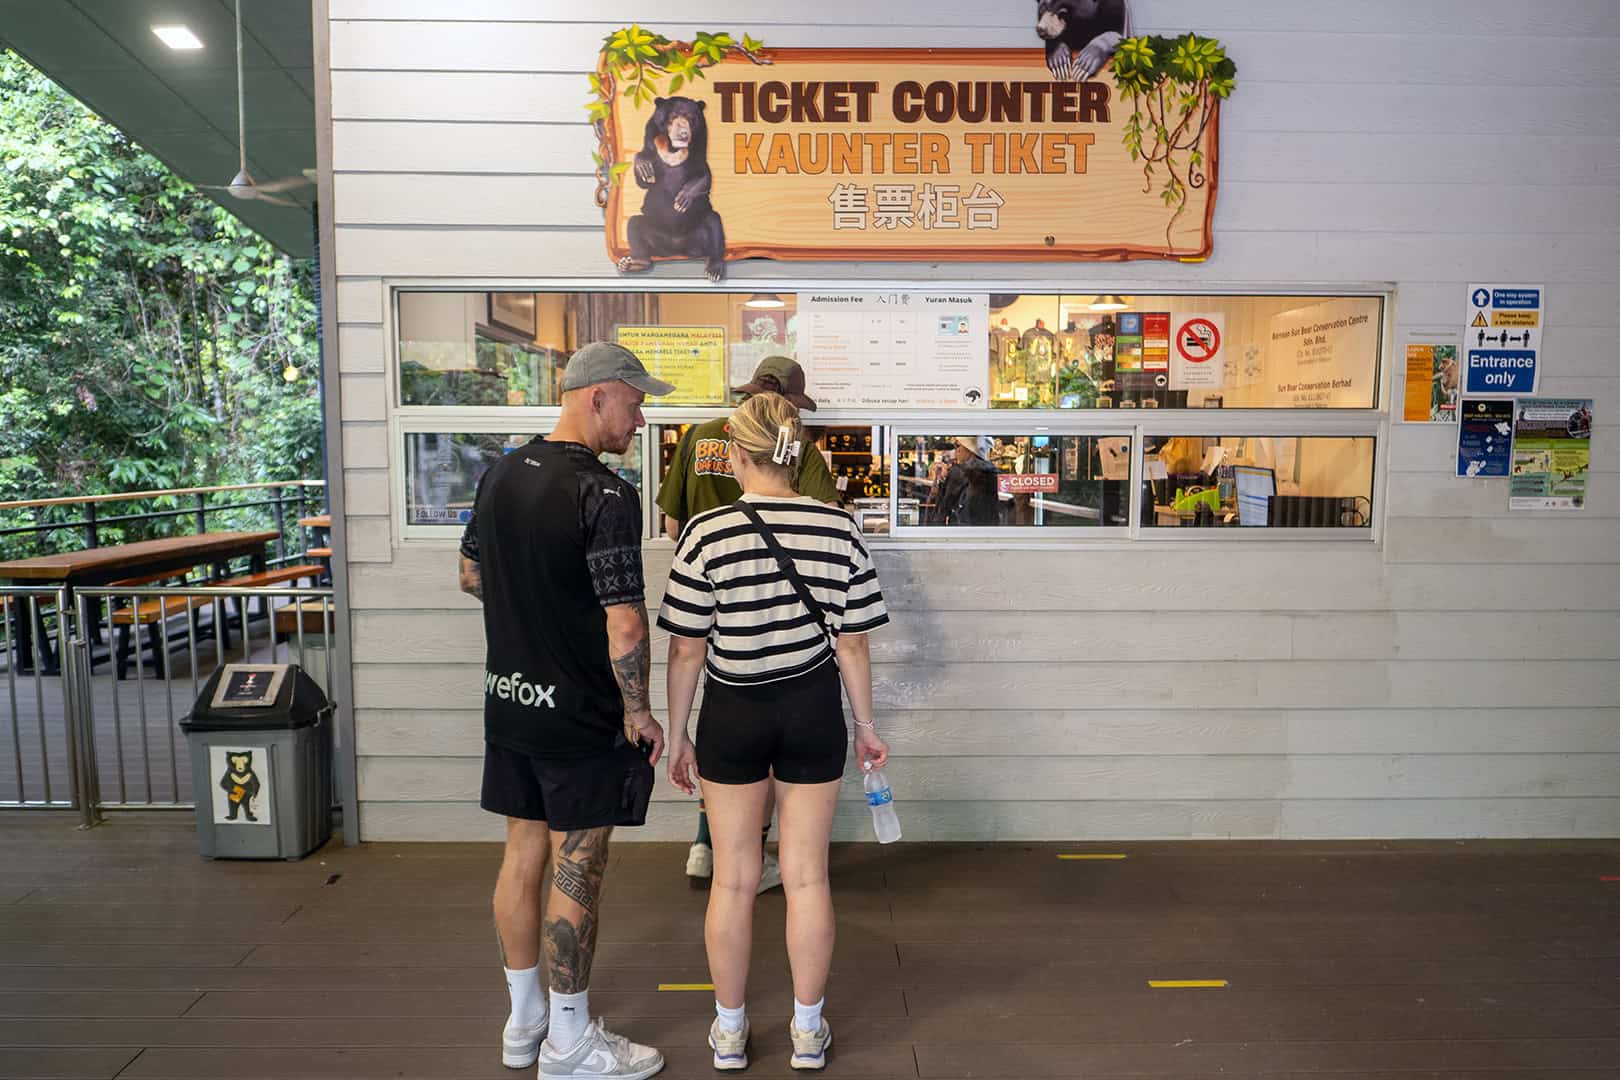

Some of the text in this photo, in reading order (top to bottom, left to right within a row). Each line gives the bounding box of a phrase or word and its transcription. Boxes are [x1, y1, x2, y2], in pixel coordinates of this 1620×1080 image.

[713, 80, 1112, 125] TICKET COUNTER
[733, 131, 1096, 175] KAUNTER TIKET
[827, 182, 1006, 232] 售票柜台
[810, 295, 864, 304] Admission Fee
[925, 296, 973, 304] Yuran Masuk
[1470, 354, 1534, 368] Entrance
[1485, 371, 1516, 387] only
[697, 440, 731, 458] BRU
[1010, 476, 1055, 487] CLOSED
[416, 510, 446, 519] FOLLOW
